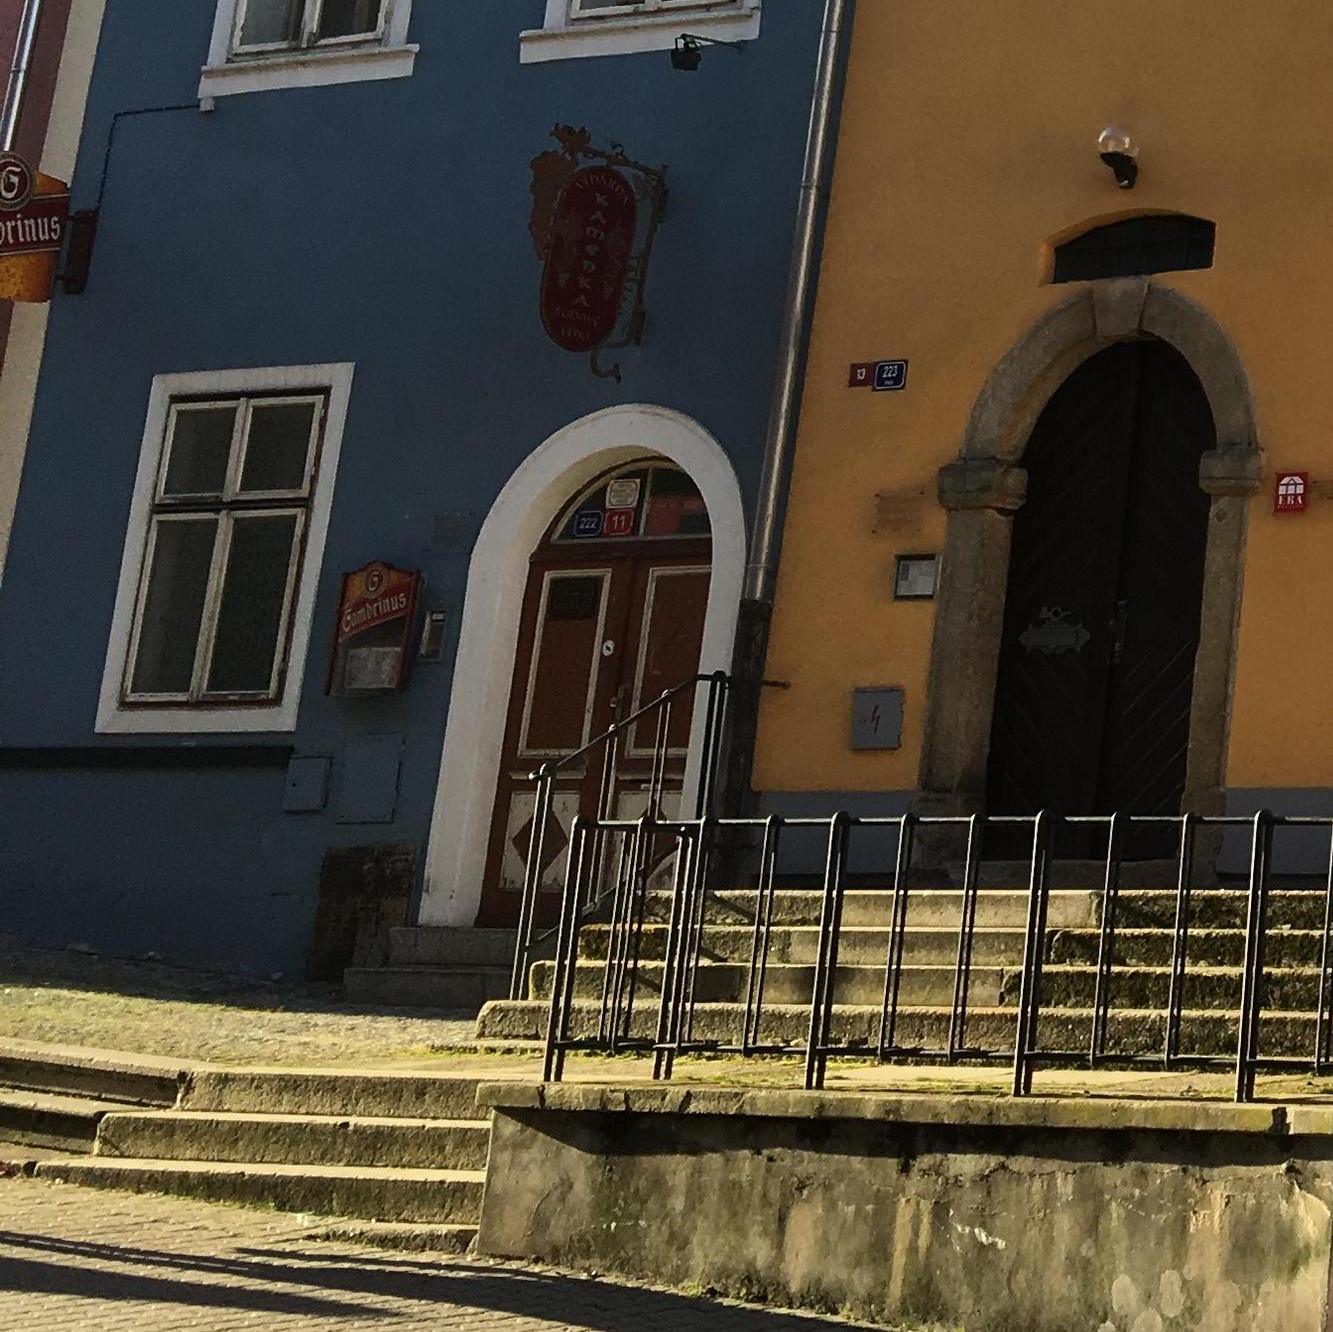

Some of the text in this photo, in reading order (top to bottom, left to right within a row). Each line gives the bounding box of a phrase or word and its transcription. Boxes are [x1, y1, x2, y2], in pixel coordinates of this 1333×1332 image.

[882, 365, 898, 378] 223
[578, 518, 598, 530] 222
[611, 515, 627, 530] 11
[342, 592, 408, 632] Gambrinus
